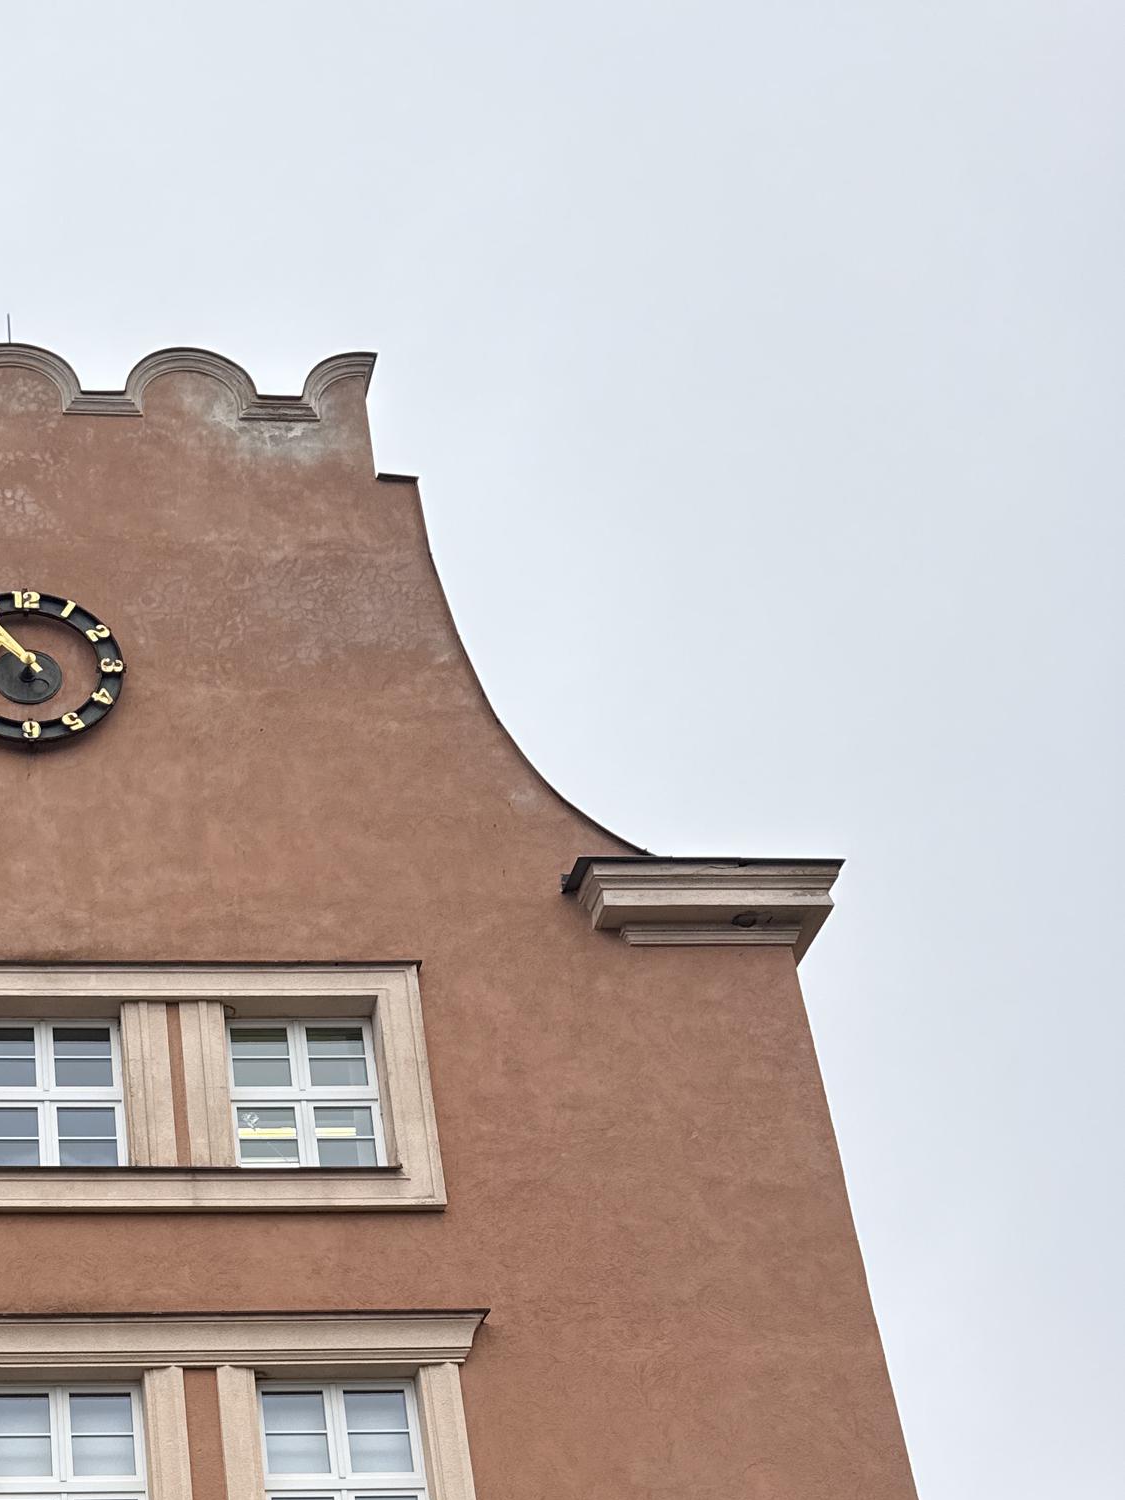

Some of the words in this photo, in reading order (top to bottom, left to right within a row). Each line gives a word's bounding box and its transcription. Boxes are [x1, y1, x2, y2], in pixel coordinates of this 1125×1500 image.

[12, 591, 40, 609] 12
[61, 600, 76, 618] 1
[86, 625, 110, 642] 2
[101, 658, 123, 672] 3
[92, 688, 113, 705] 4
[62, 712, 85, 730] 5
